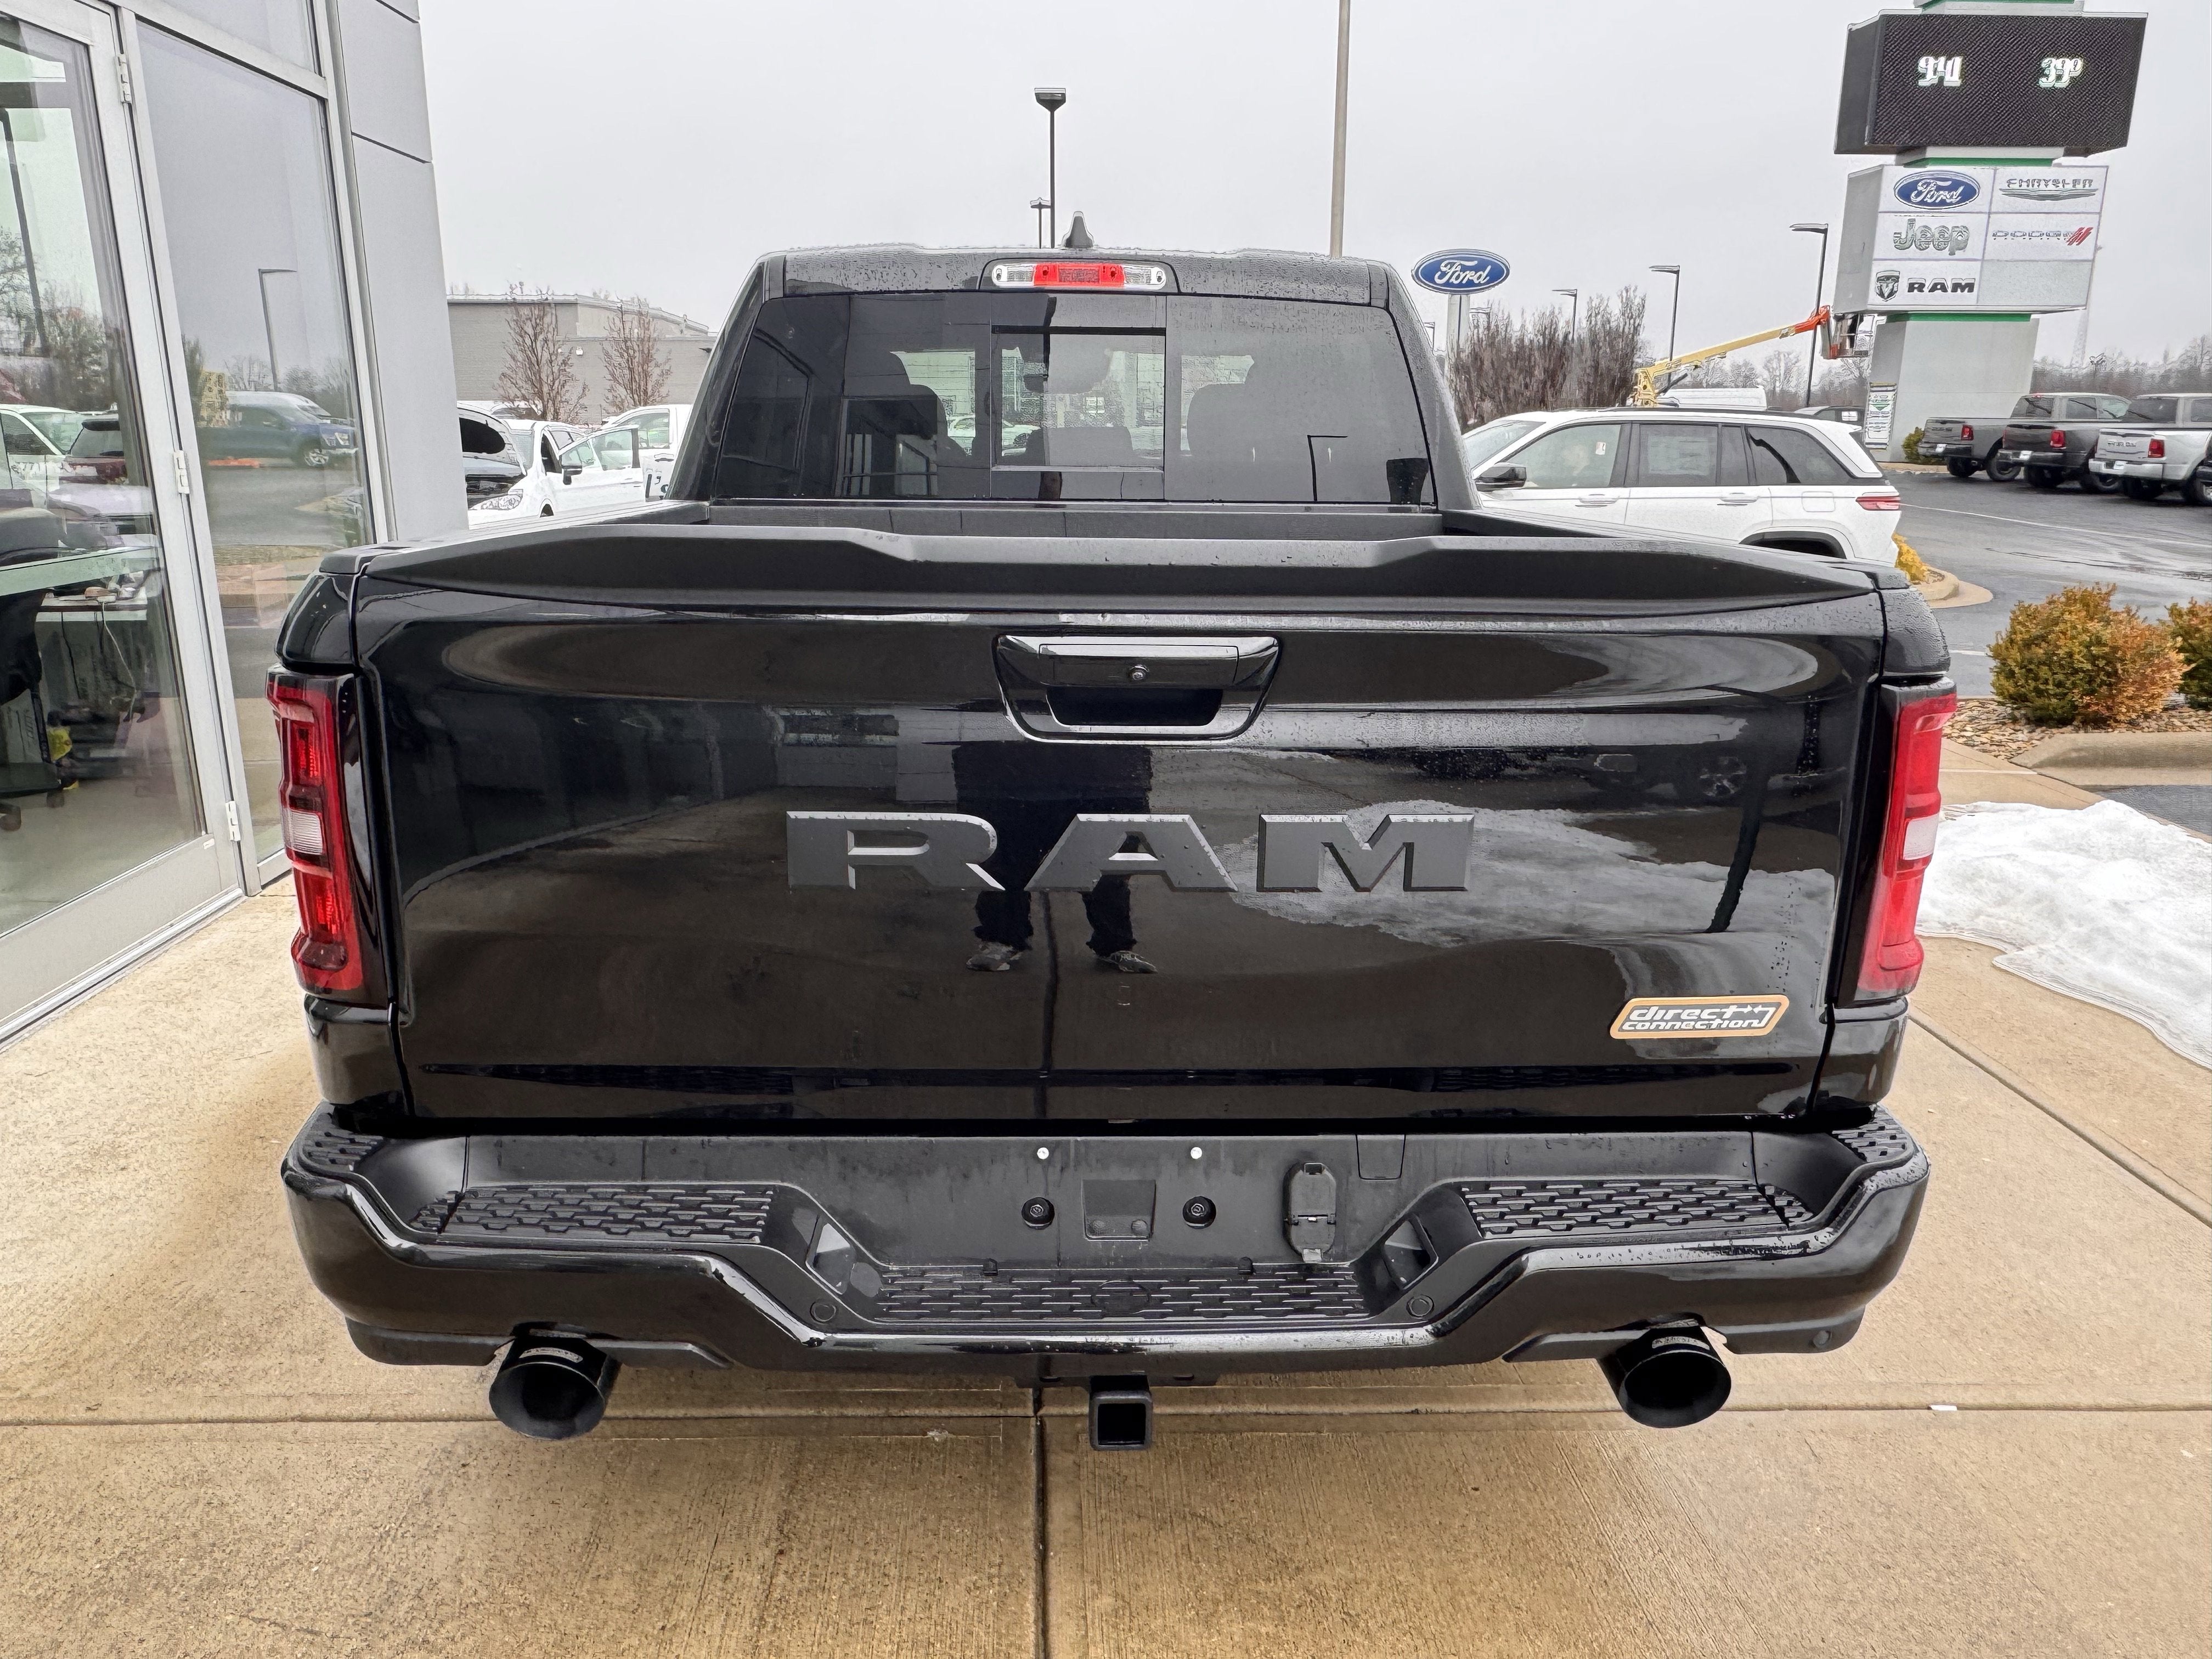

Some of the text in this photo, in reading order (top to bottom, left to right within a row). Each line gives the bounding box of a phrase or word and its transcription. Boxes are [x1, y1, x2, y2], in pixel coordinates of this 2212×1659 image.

[1910, 179, 1965, 204] Ford
[1893, 218, 1971, 256] Jeep
[1434, 259, 1492, 284] Ford
[1907, 278, 1976, 294] RAM
[786, 810, 1475, 893] RAM
[1622, 1018, 1767, 1030] connection
[1629, 1005, 1752, 1020] direct
